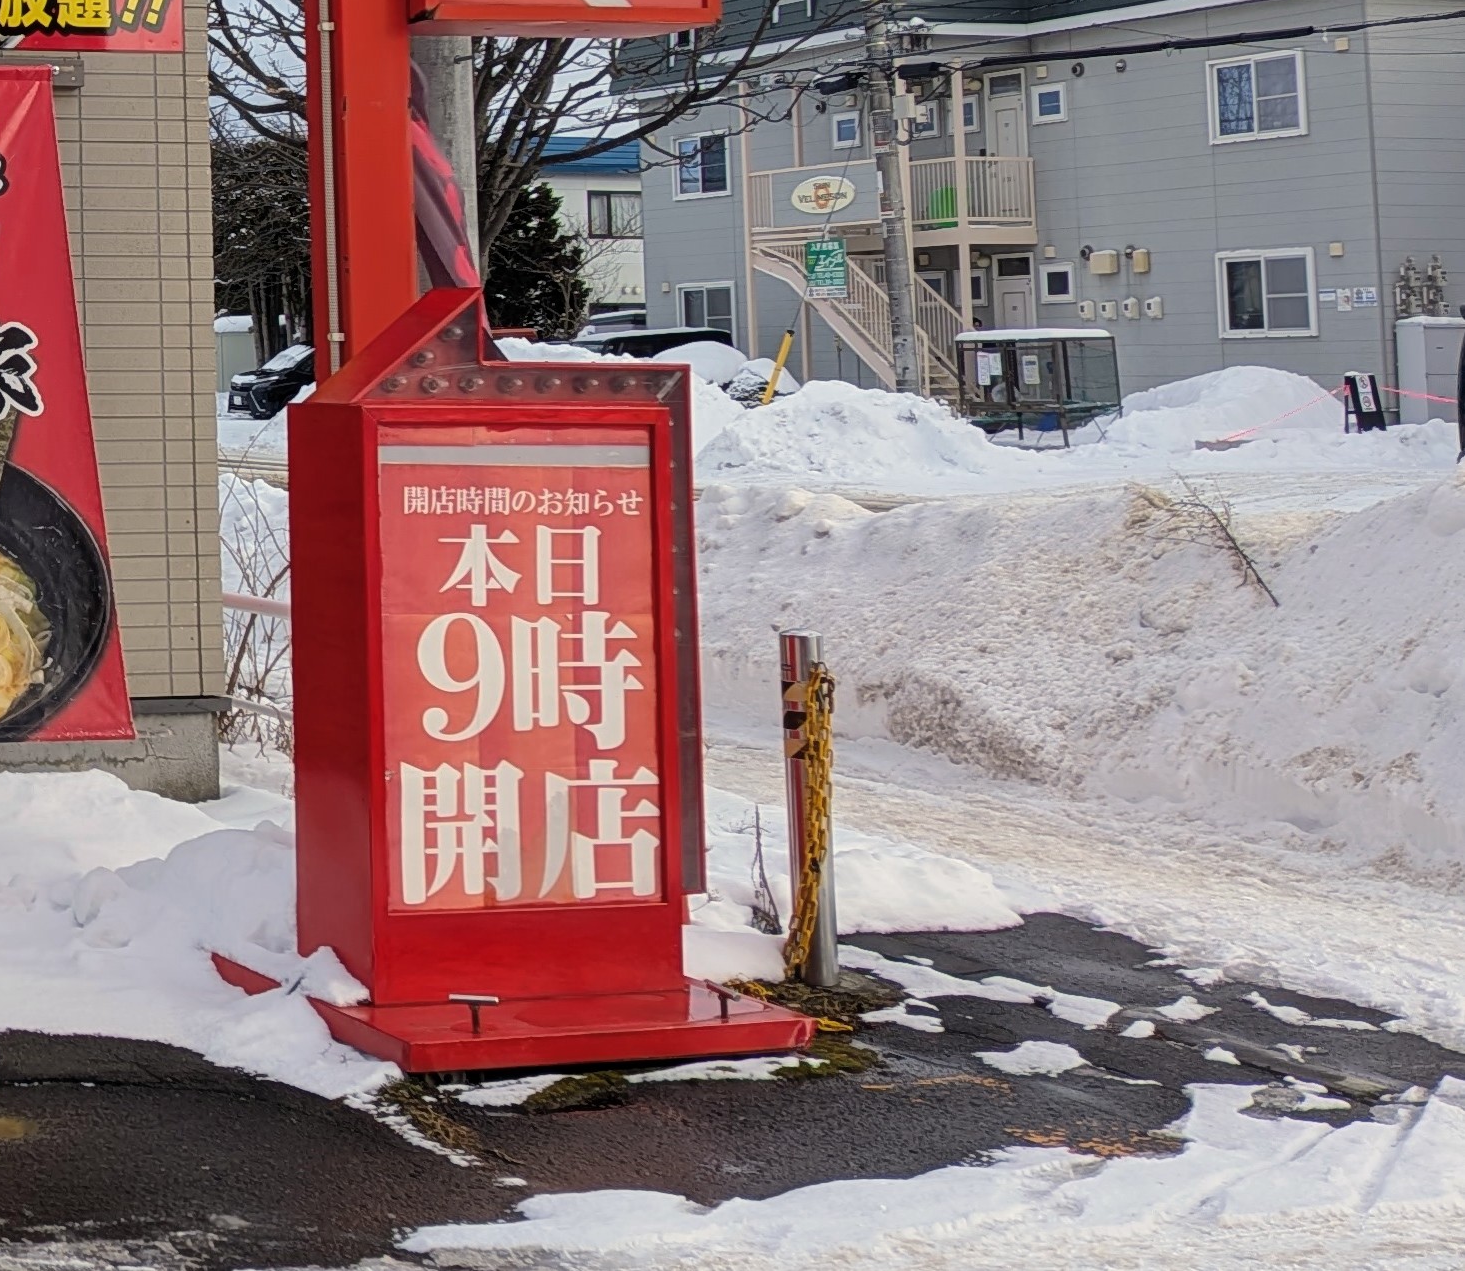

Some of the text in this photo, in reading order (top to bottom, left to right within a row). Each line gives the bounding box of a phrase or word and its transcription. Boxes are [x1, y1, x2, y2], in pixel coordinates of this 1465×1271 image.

[402, 485, 644, 517] 開店時間のお知らせ
[437, 523, 601, 607] 本日
[416, 610, 644, 751] 9時
[400, 759, 661, 906] 開店
